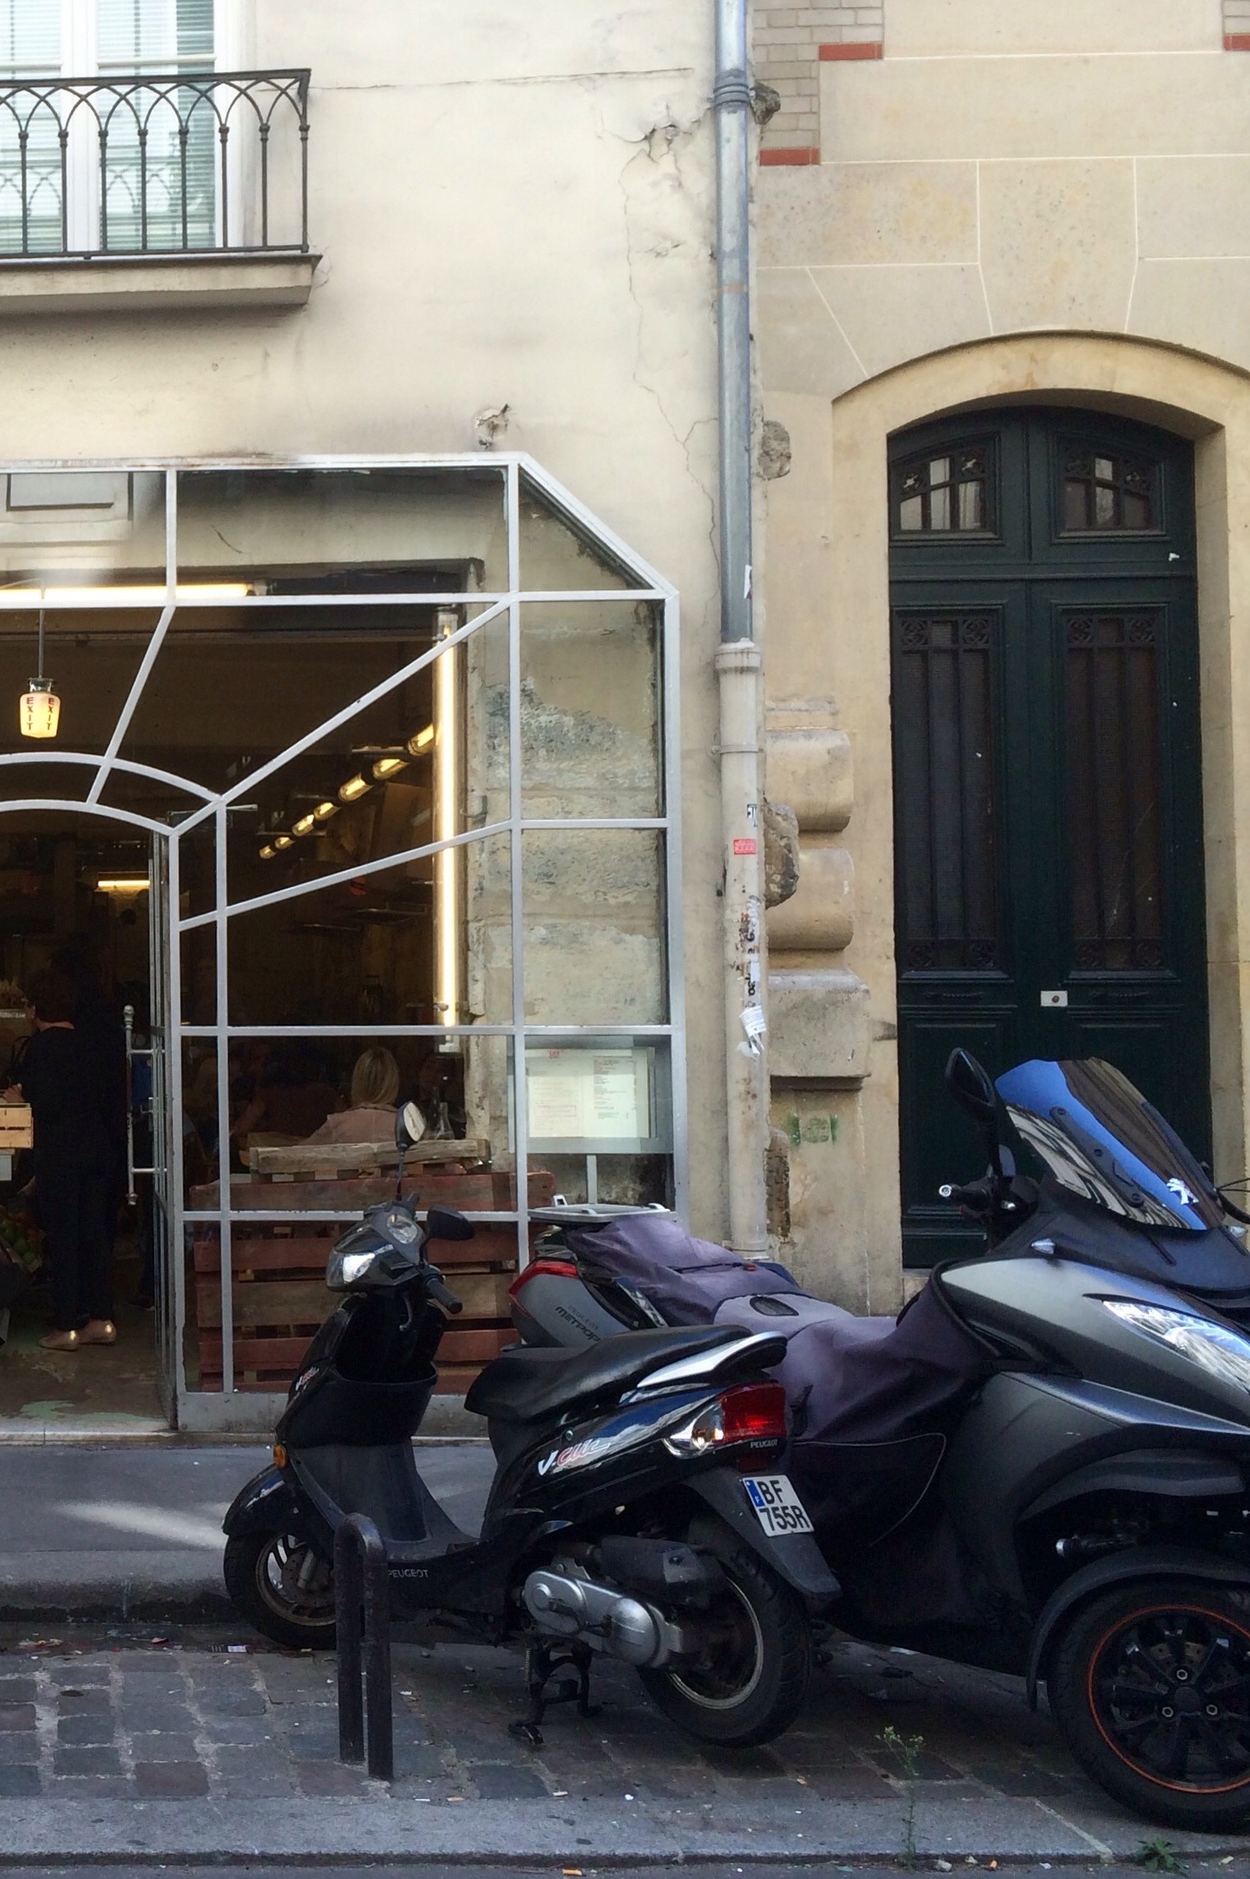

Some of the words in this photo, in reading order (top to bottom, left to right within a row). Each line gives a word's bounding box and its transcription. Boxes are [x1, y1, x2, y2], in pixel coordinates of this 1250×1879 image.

[26, 696, 34, 731] EXIT
[47, 697, 55, 731] EXIT
[756, 1480, 783, 1505] BF
[759, 1505, 810, 1532] 755R
